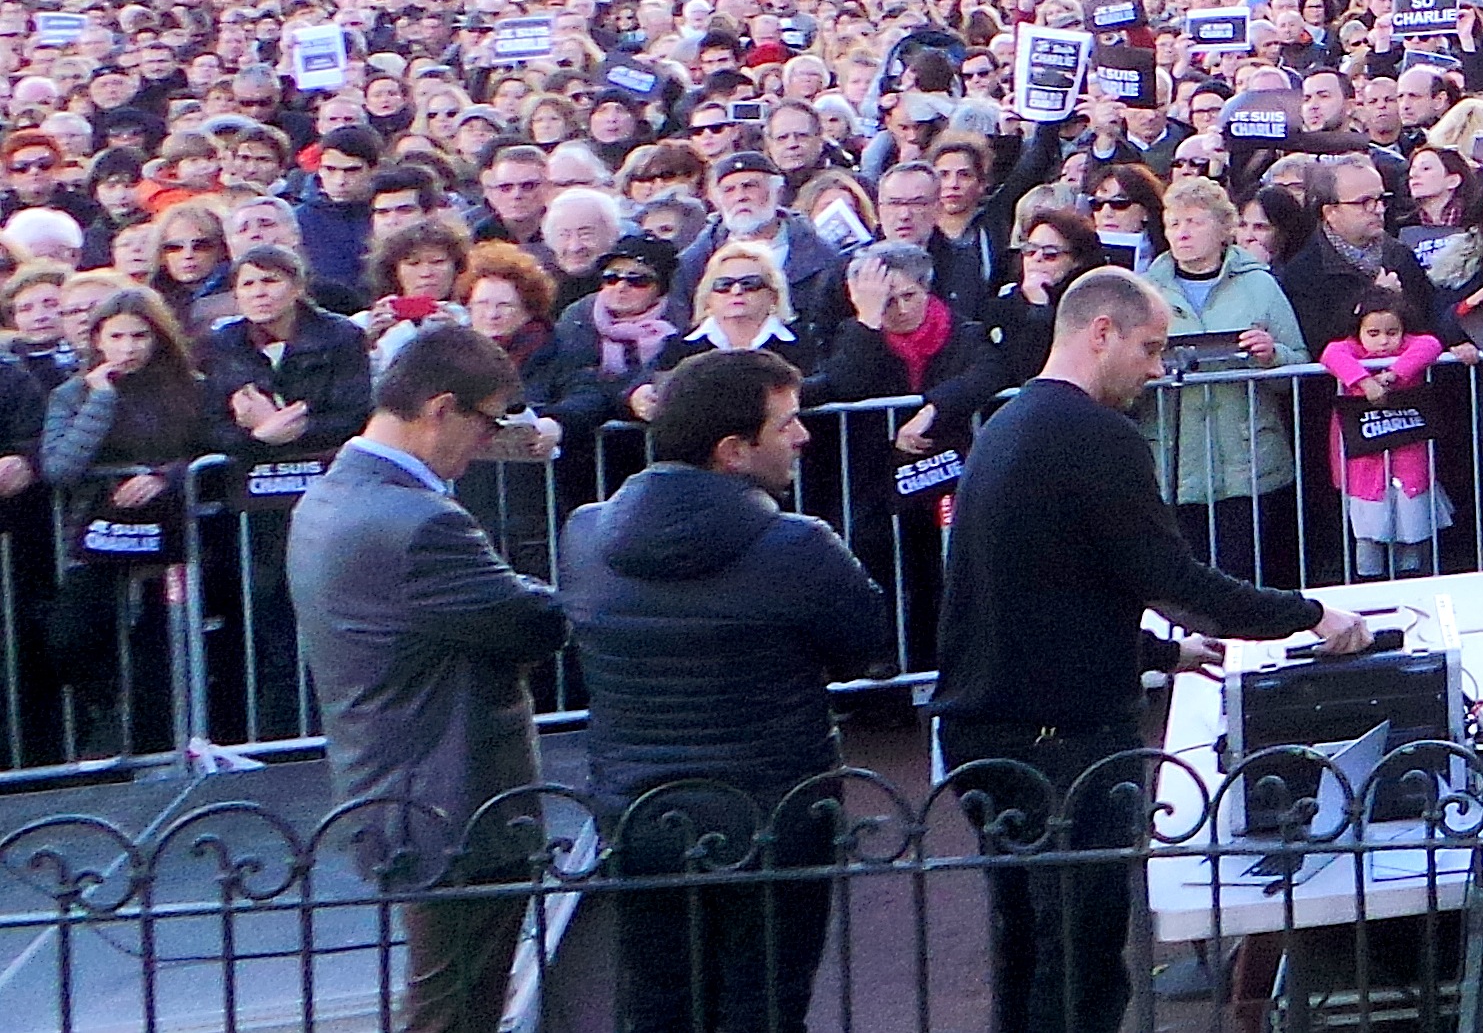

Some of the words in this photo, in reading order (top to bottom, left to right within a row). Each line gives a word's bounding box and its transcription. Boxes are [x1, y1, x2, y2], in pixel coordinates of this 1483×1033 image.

[1393, 9, 1456, 26] CHARLIE
[1230, 112, 1250, 122] JE
[1254, 111, 1285, 122] SUIS
[1230, 122, 1286, 138] CHARLIE
[1360, 410, 1381, 422] JE
[1382, 409, 1420, 418] SUIS
[1361, 416, 1426, 438] CHARLIE
[895, 464, 917, 479] JE
[915, 450, 959, 472] SUIS
